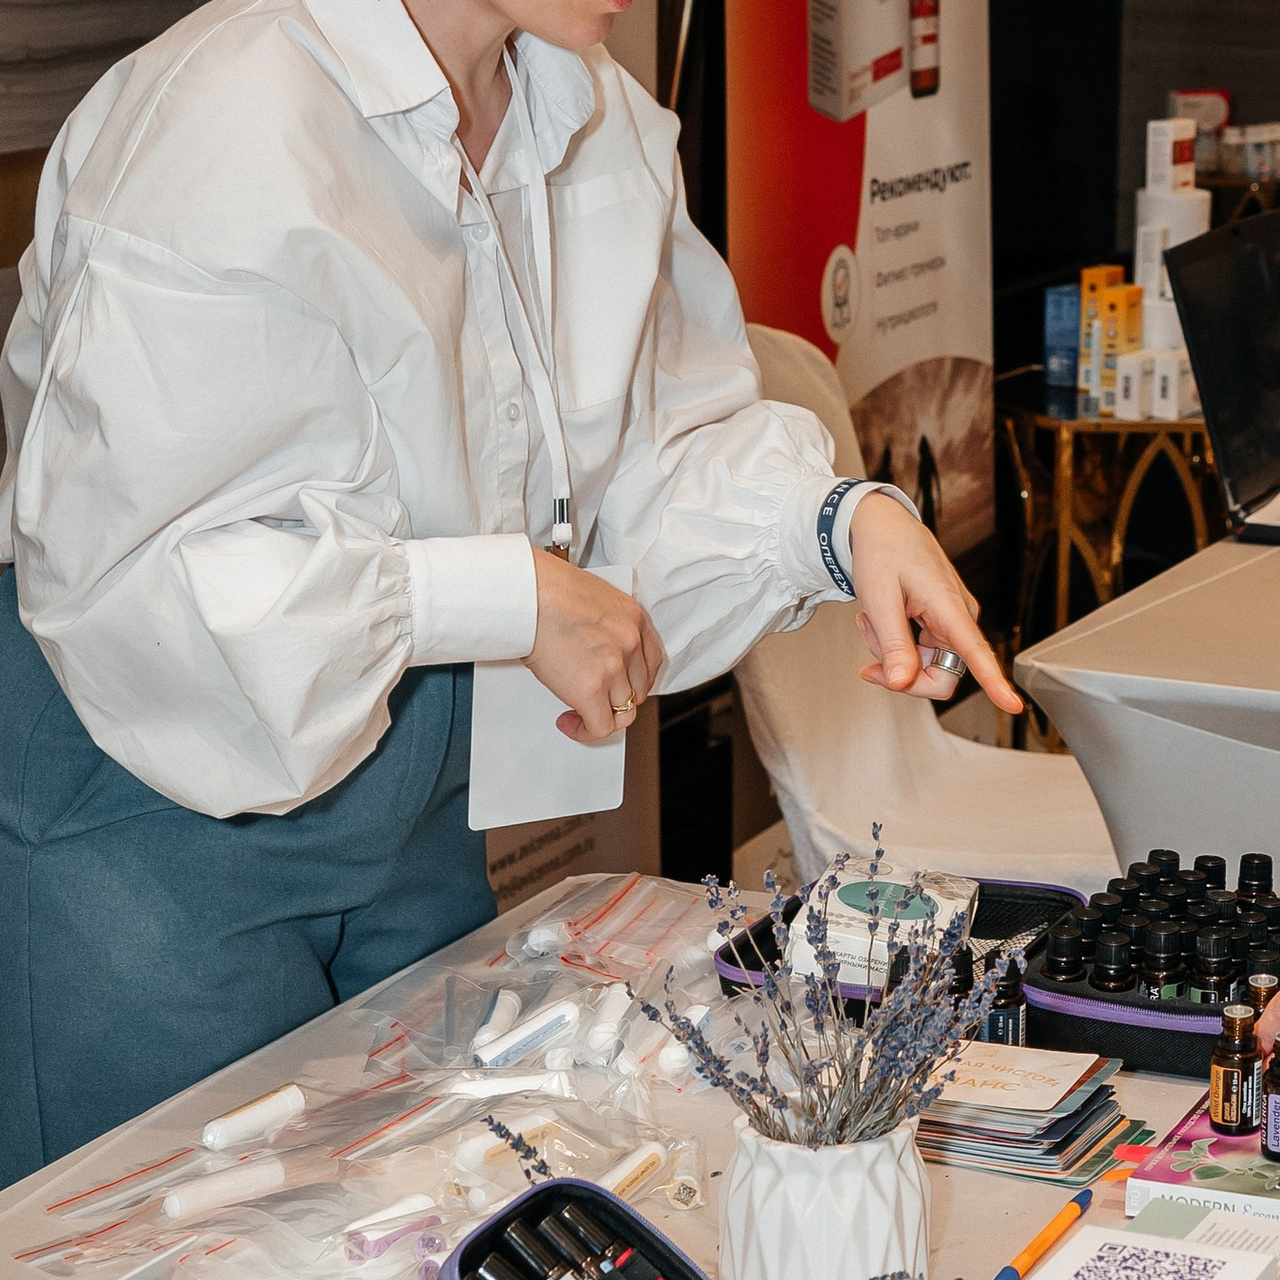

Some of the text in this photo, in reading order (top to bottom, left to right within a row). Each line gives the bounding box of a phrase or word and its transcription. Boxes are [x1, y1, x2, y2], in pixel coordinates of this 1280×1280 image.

[1213, 1069, 1222, 1119] Wild Orange
[1271, 1099, 1280, 1148] Lavender
